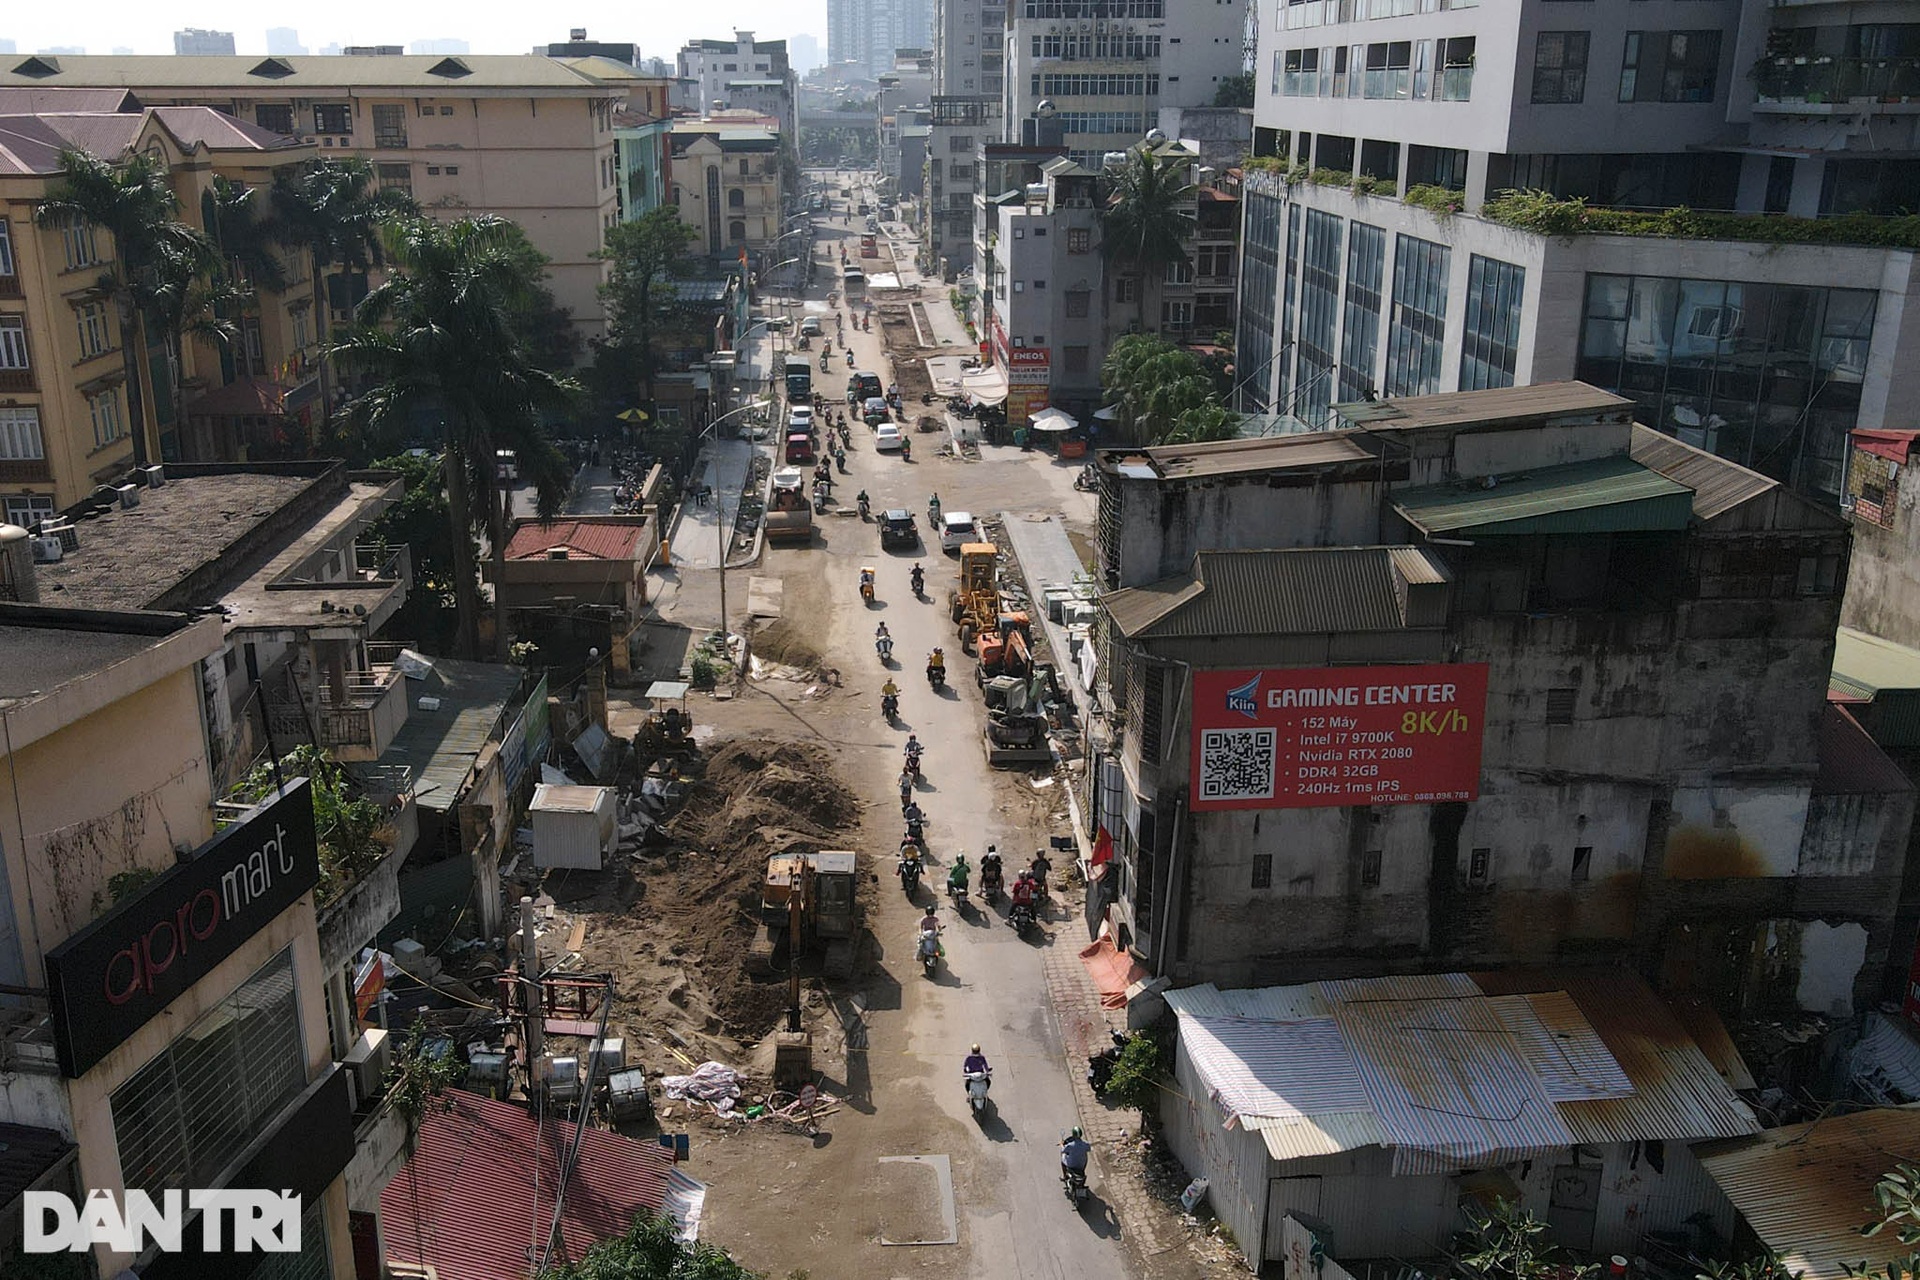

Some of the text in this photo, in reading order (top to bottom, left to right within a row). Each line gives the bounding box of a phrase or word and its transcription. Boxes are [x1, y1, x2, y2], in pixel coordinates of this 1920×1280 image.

[1013, 352, 1044, 360] ENEOS
[1267, 684, 1456, 708] GAMING CENTER
[1229, 698, 1256, 711] Kiin
[1301, 716, 1357, 731] 152 Máy
[1401, 709, 1468, 736] 8K/h
[1300, 731, 1394, 745] Intel i7 9700K
[1299, 747, 1413, 762] Nvidia RTX 2080
[1299, 765, 1379, 778] DDR4 32GB
[1297, 780, 1400, 795] 240Hz 1ms IPS
